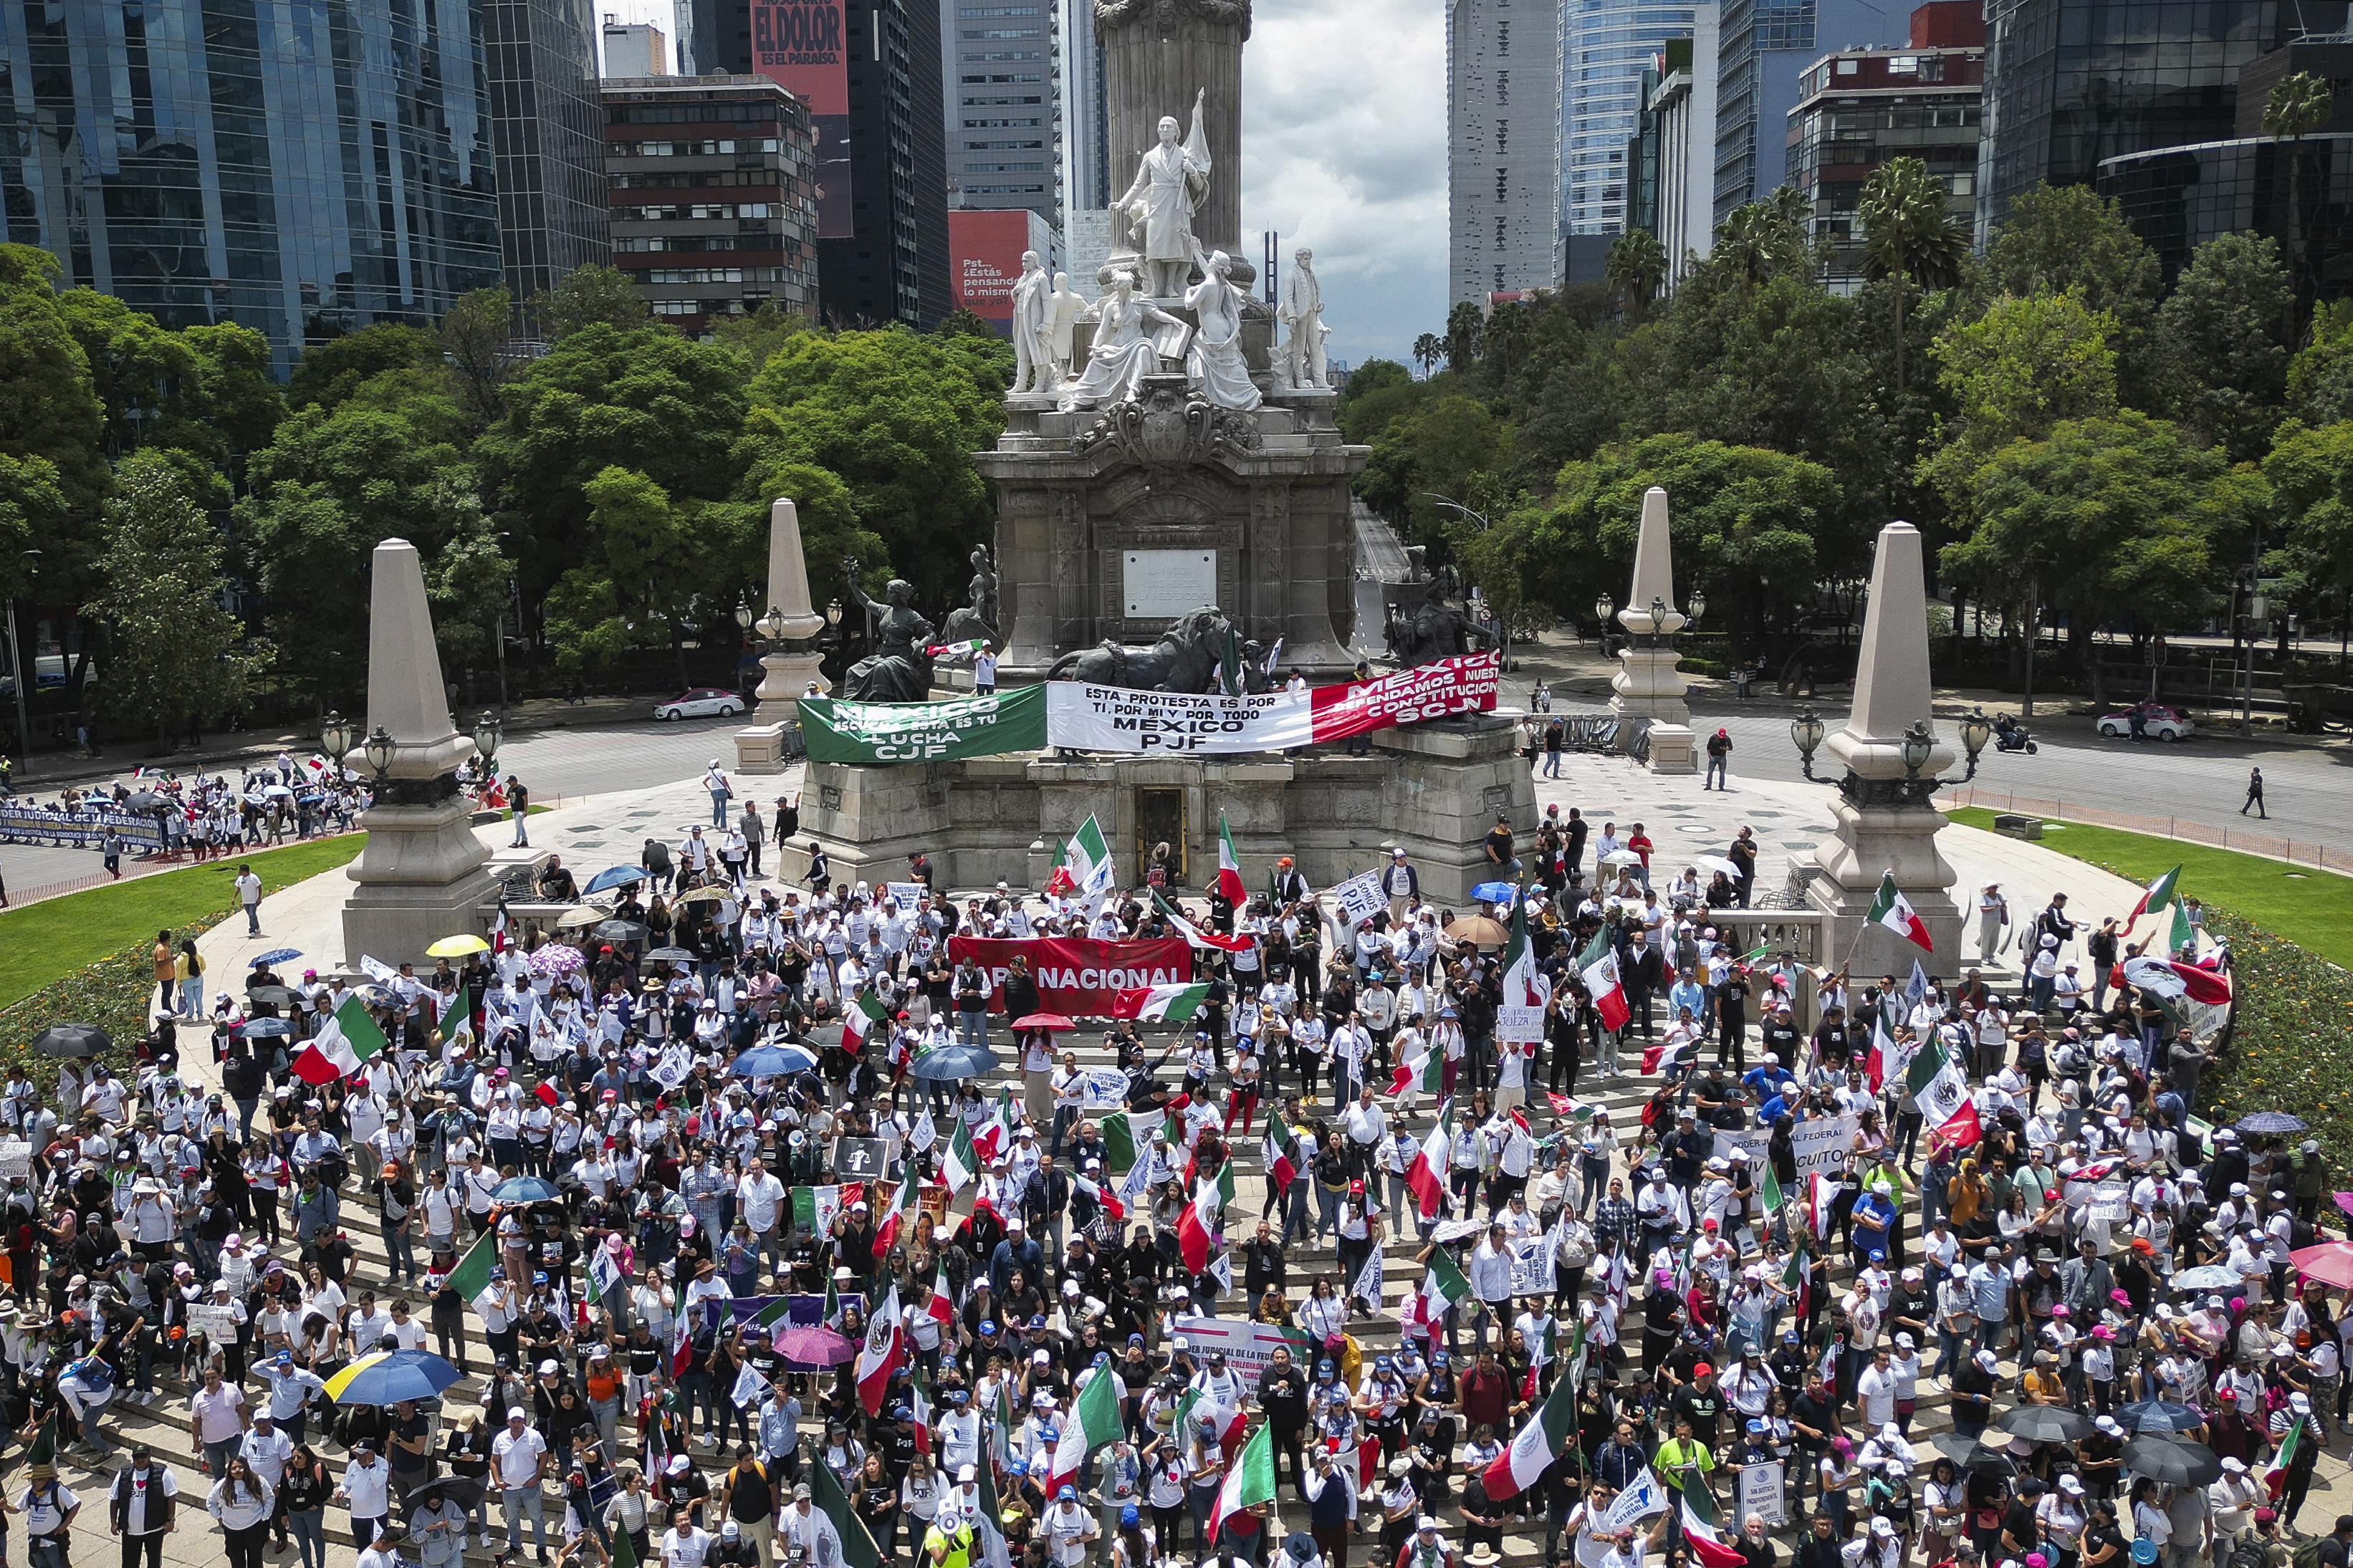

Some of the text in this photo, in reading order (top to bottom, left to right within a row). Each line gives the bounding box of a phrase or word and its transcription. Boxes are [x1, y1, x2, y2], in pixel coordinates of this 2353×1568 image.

[754, 6, 841, 52] EL DOLOR
[762, 53, 774, 64] ES
[775, 53, 788, 64] EL
[964, 259, 992, 268] Pst...
[964, 268, 1002, 277] ¿Estás
[964, 287, 975, 296] lo
[989, 297, 1008, 307] yo?
[1334, 672, 1455, 711] DEFENDAMOS
[1086, 687, 1276, 708] ESTA PROTESTA ES POR
[1367, 682, 1499, 718] CONSTITUCION
[1092, 702, 1260, 721] TI, POR MI Y POR TODO
[1395, 697, 1481, 723] SCJN
[955, 717, 972, 728] ES
[977, 713, 997, 726] TU
[872, 731, 962, 746] LUCHA
[1141, 734, 1207, 750] PJF
[875, 744, 947, 759] CJF
[0, 809, 22, 818] DER
[24, 810, 72, 822] JUDICIAL
[74, 813, 90, 822] DE
[91, 813, 101, 822] LA
[1342, 888, 1366, 914] PJF
[1357, 882, 1379, 911] SOMOS
[1421, 930, 1434, 939] PJF
[1038, 967, 1178, 990] NACIONAL
[1499, 1016, 1529, 1026] JUEZA
[1803, 1129, 1844, 1141] FEDERAL
[1796, 1149, 1844, 1169] CUITO
[1908, 1301, 1925, 1311] PJF
[1236, 1349, 1245, 1357] DE
[1246, 1350, 1255, 1358] LA
[1835, 1344, 1845, 1355] JF
[1231, 1360, 1265, 1370] COLEGIADO
[1783, 1365, 1801, 1373] PF
[1244, 1371, 1262, 1380] CIRCU
[1035, 1385, 1054, 1394] PJF
[897, 1437, 914, 1448] PJF
[1747, 1453, 1766, 1463] PJF
[914, 1488, 930, 1498] PJF
[790, 1549, 802, 1558] PJF
